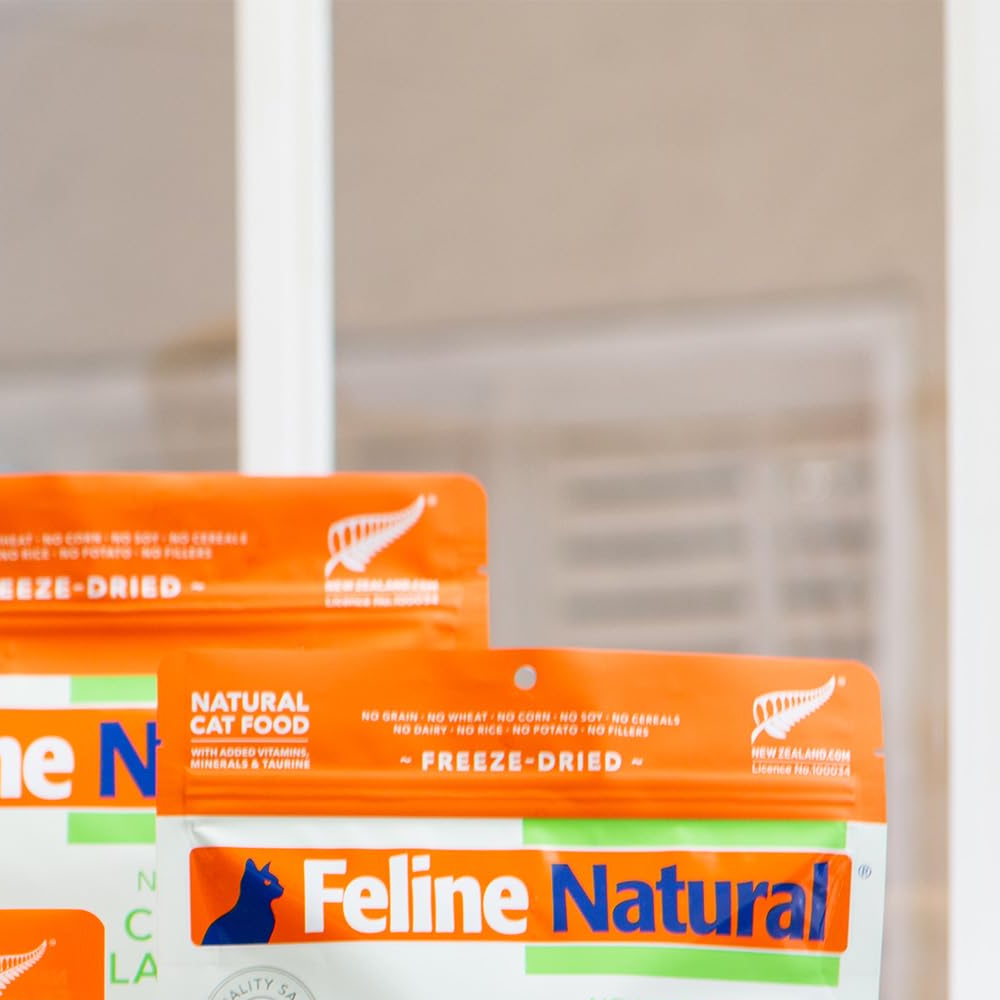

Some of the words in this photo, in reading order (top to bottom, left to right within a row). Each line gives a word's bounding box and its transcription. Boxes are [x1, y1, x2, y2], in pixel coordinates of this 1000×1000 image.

[191, 691, 310, 712] NATURAL
[190, 715, 235, 735] CAT
[241, 715, 310, 734] FOOD
[361, 711, 379, 721] NO
[382, 711, 418, 722] GRAIN
[427, 711, 445, 722] NO
[449, 712, 487, 722] WHEAT
[497, 711, 515, 722] NO
[518, 712, 550, 722] CORN
[560, 712, 578, 722] NO
[581, 712, 602, 723] SOY
[612, 712, 629, 724] NO
[632, 713, 680, 726] CEREALS
[191, 748, 218, 757] WITH
[220, 748, 255, 758] ADDED
[422, 751, 622, 772] FREEZE-DRIED
[303, 852, 528, 935] Feline
[551, 861, 829, 941] Natural
